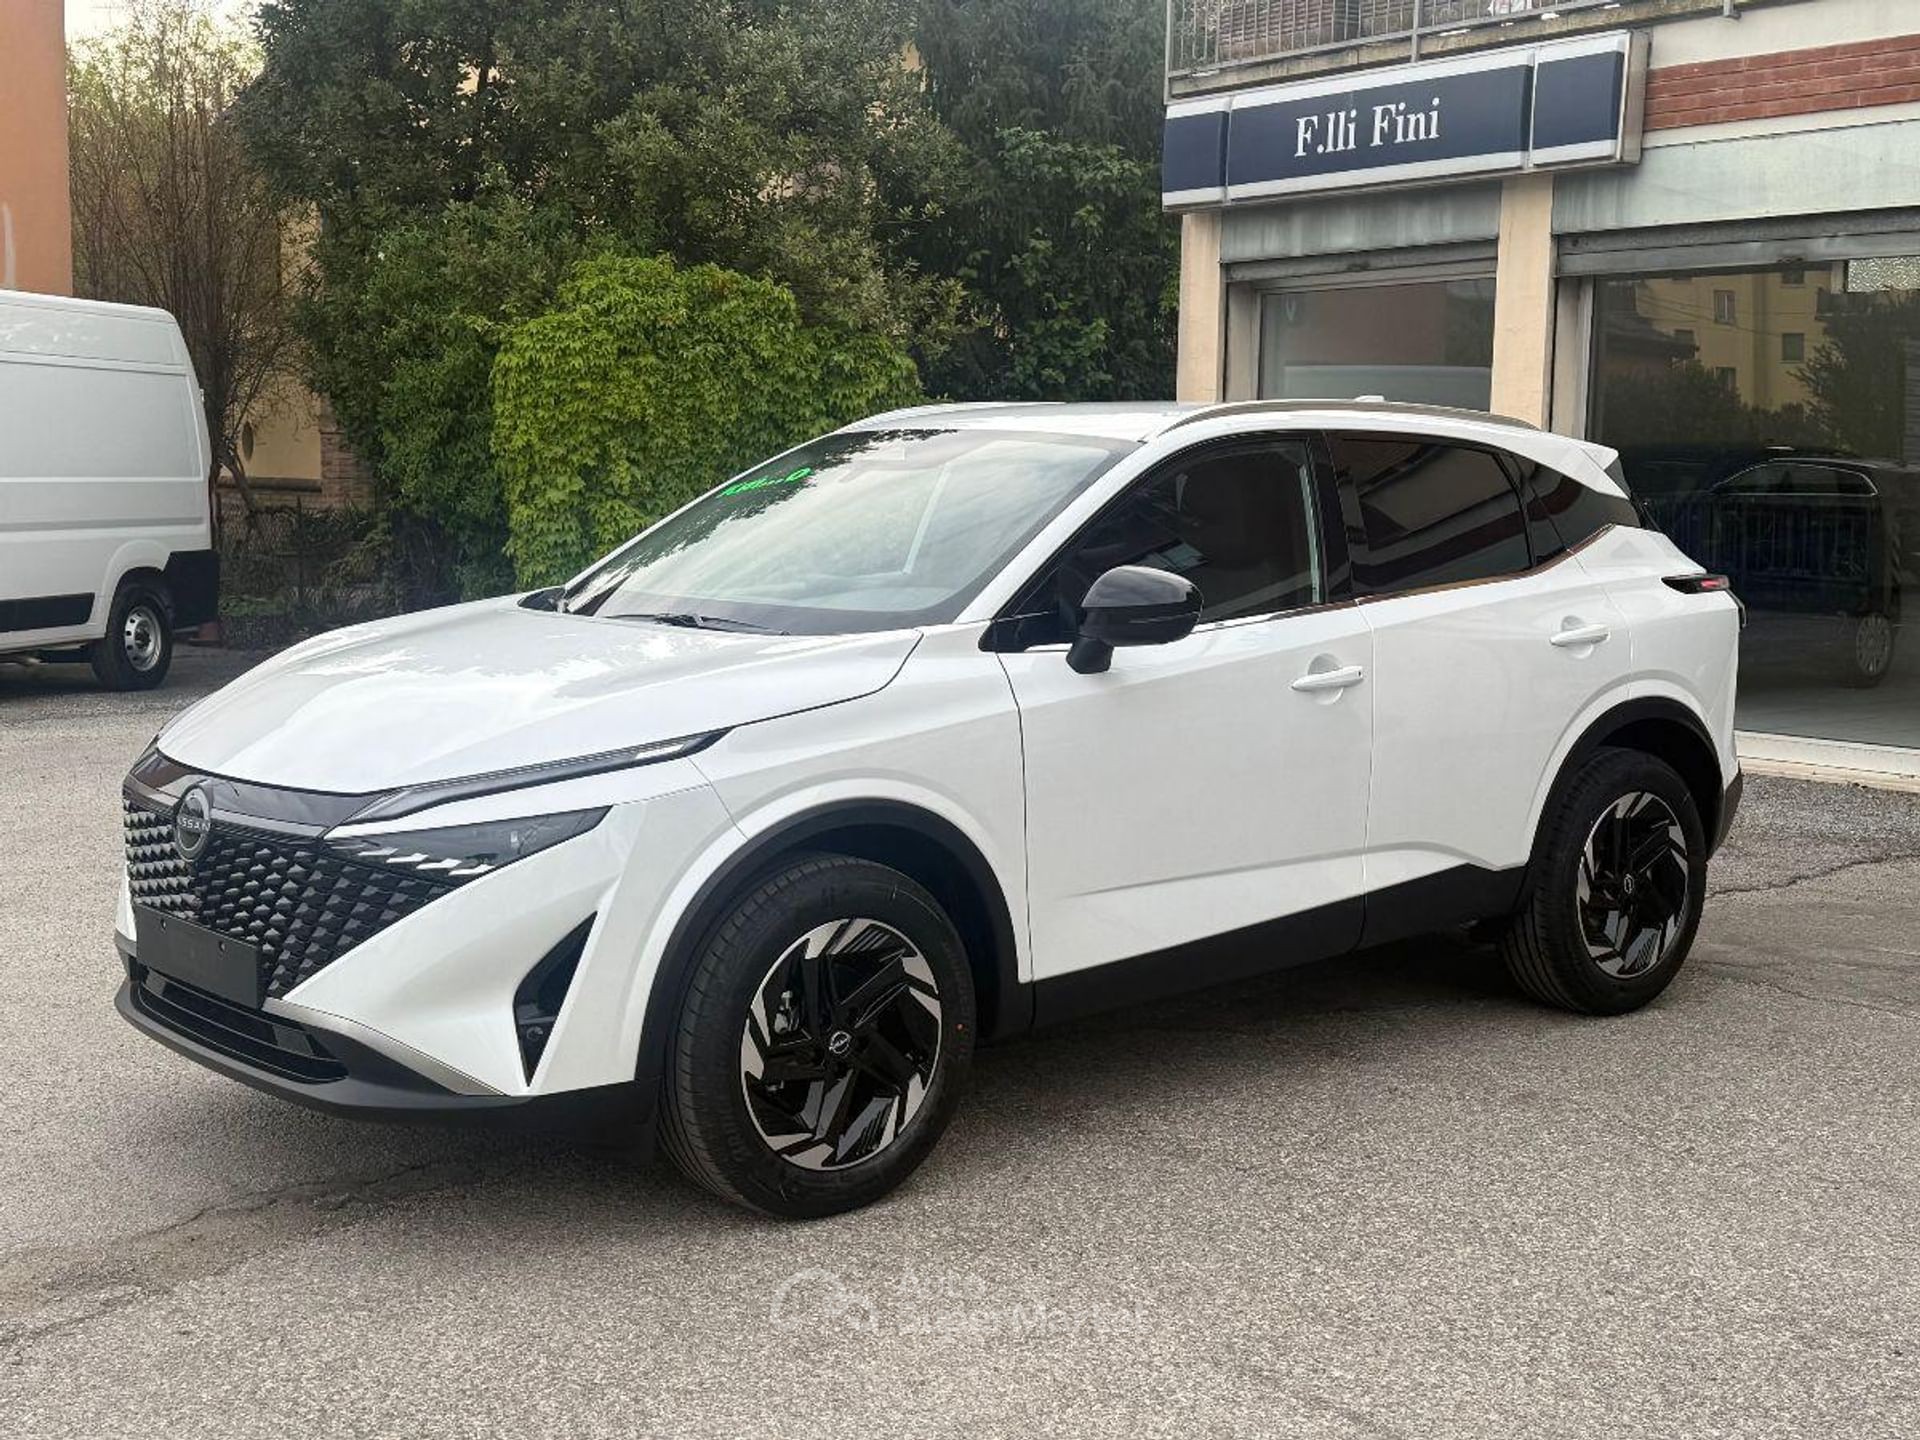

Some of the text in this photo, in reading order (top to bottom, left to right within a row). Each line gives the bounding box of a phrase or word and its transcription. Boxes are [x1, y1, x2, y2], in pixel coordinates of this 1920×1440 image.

[1294, 97, 1440, 157] F.lli Fini
[177, 815, 212, 833] SSAN
